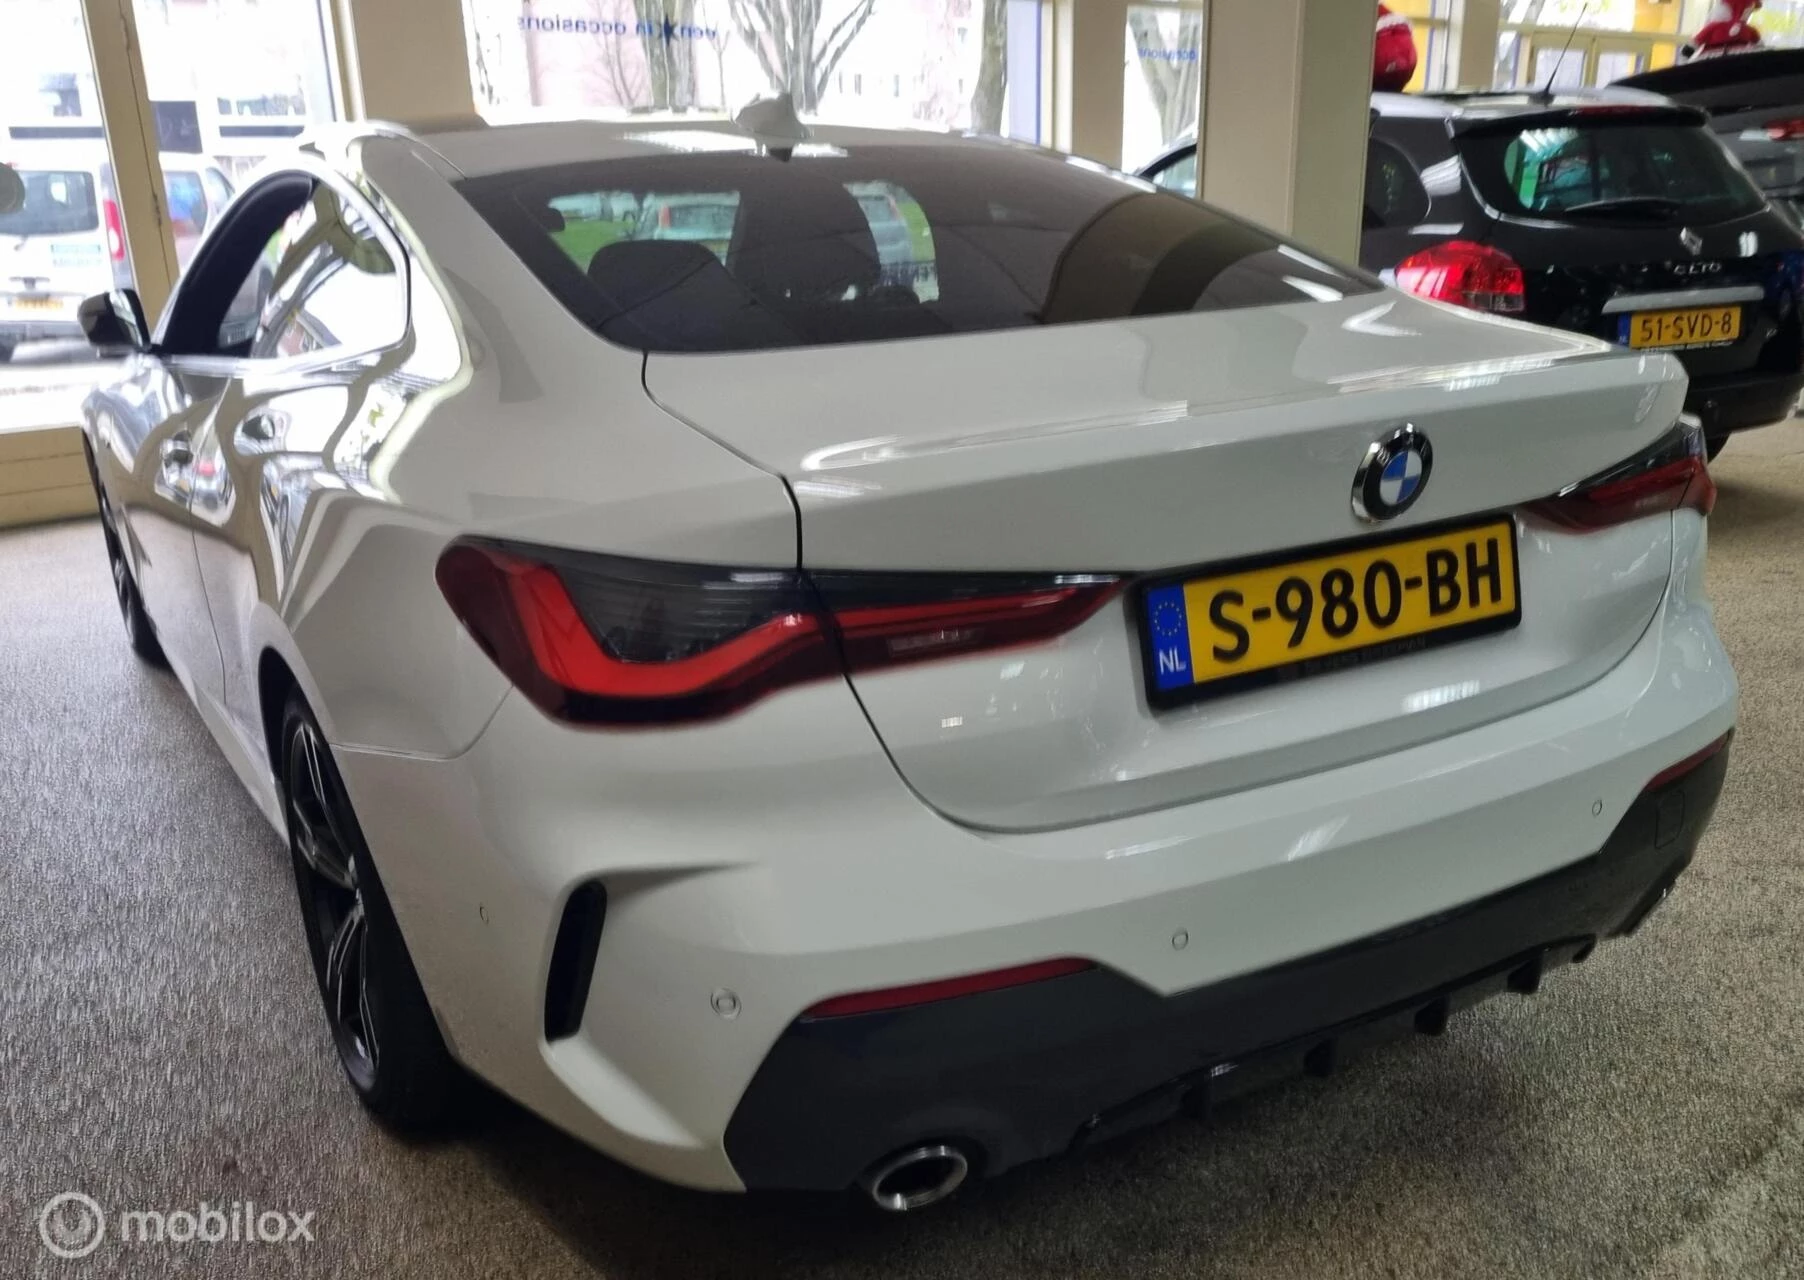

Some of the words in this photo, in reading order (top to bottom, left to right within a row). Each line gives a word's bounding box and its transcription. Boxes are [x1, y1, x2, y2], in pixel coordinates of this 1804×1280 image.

[1641, 310, 1732, 341] 51-SVD-8
[1158, 645, 1187, 675] NL
[1208, 537, 1503, 663] S-980-BH
